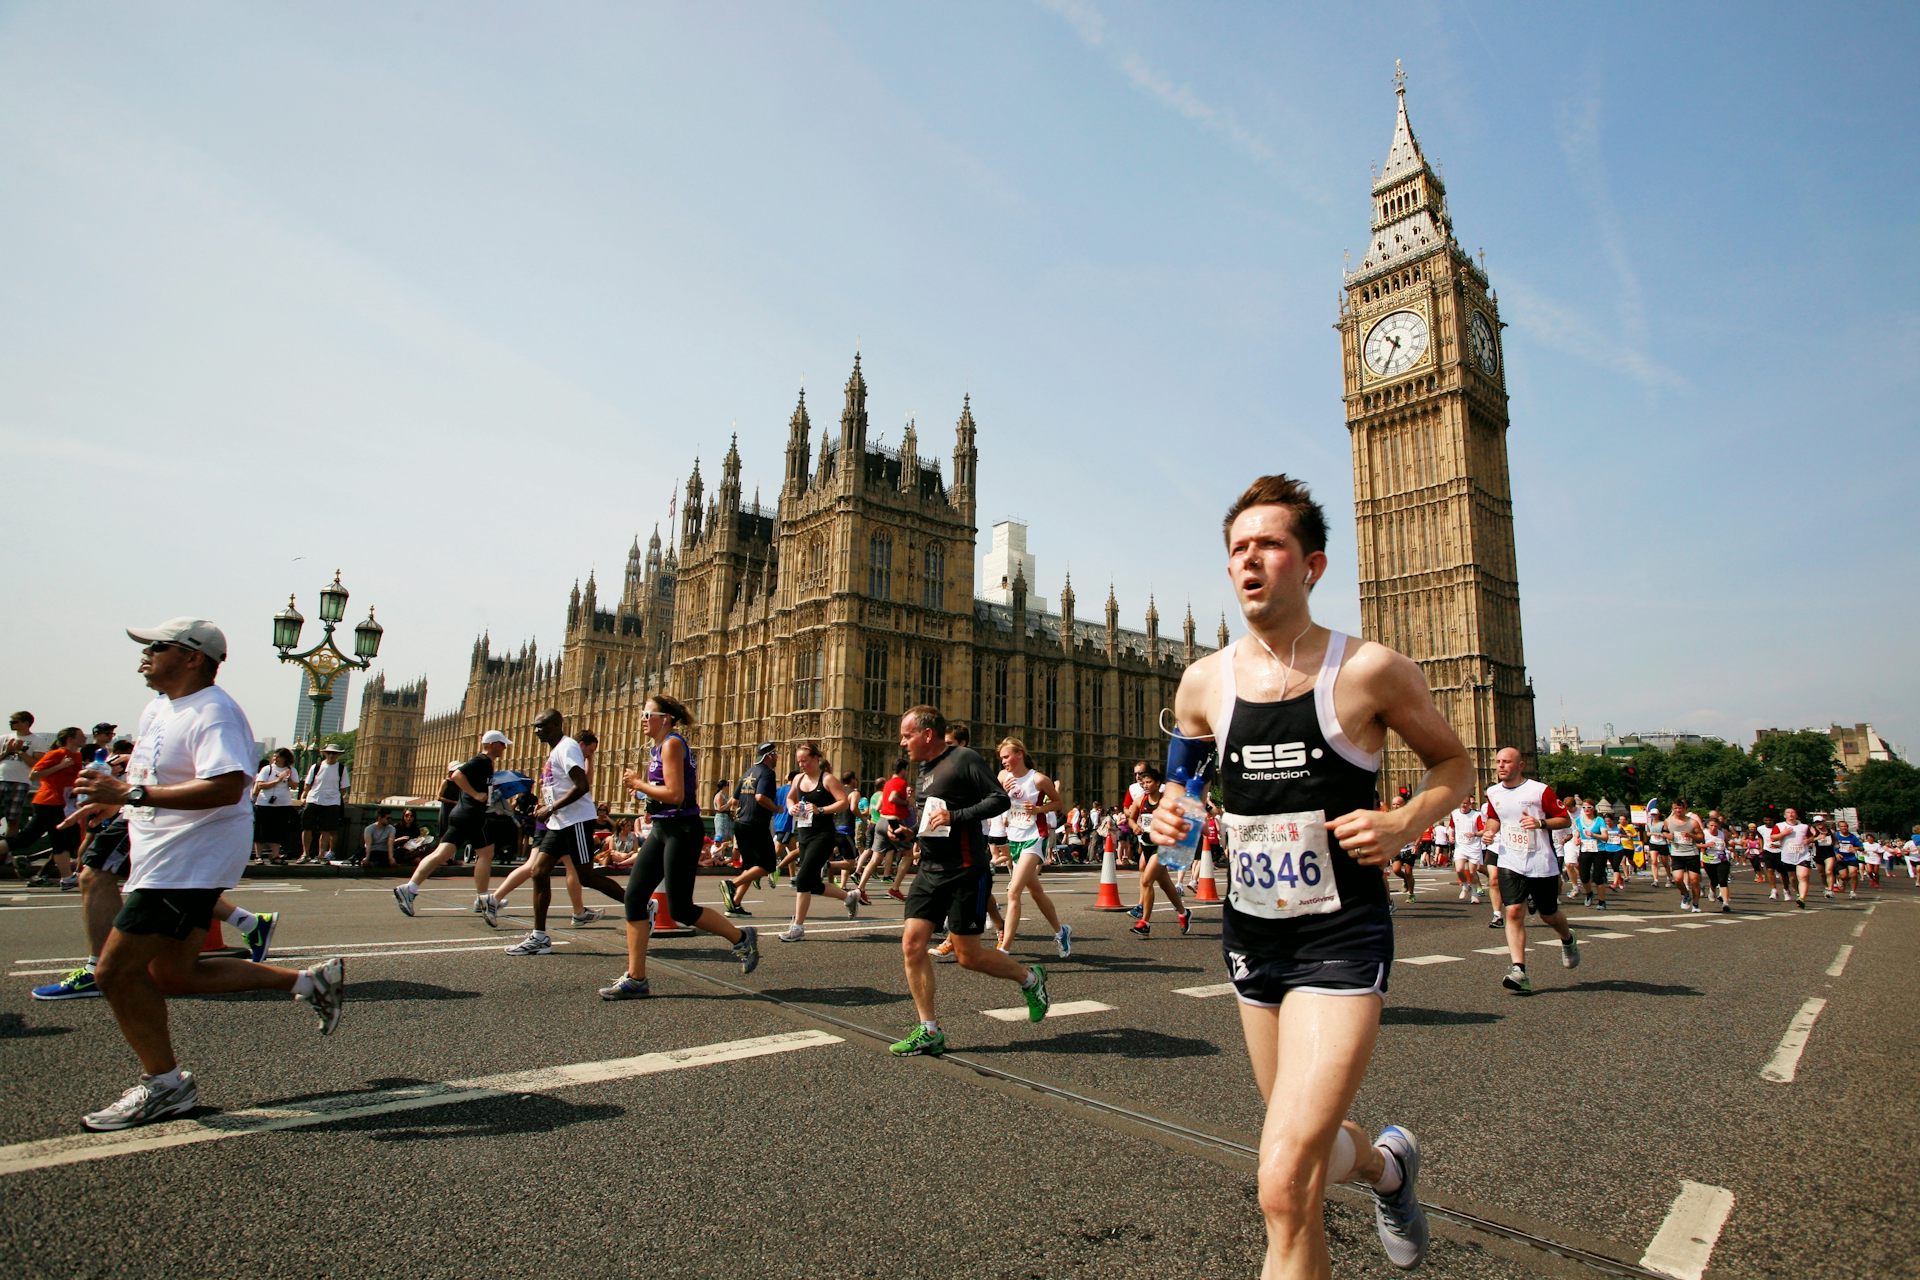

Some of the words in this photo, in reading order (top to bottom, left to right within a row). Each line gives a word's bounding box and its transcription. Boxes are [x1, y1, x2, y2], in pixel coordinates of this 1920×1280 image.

[1242, 741, 1306, 769] ES
[1242, 770, 1310, 781] collection
[1238, 824, 1268, 834] BRITISH
[1272, 824, 1286, 833] 10K
[1239, 833, 1269, 843] LONDON
[1271, 833, 1288, 843] RUN
[1298, 894, 1335, 906] JustGiving
